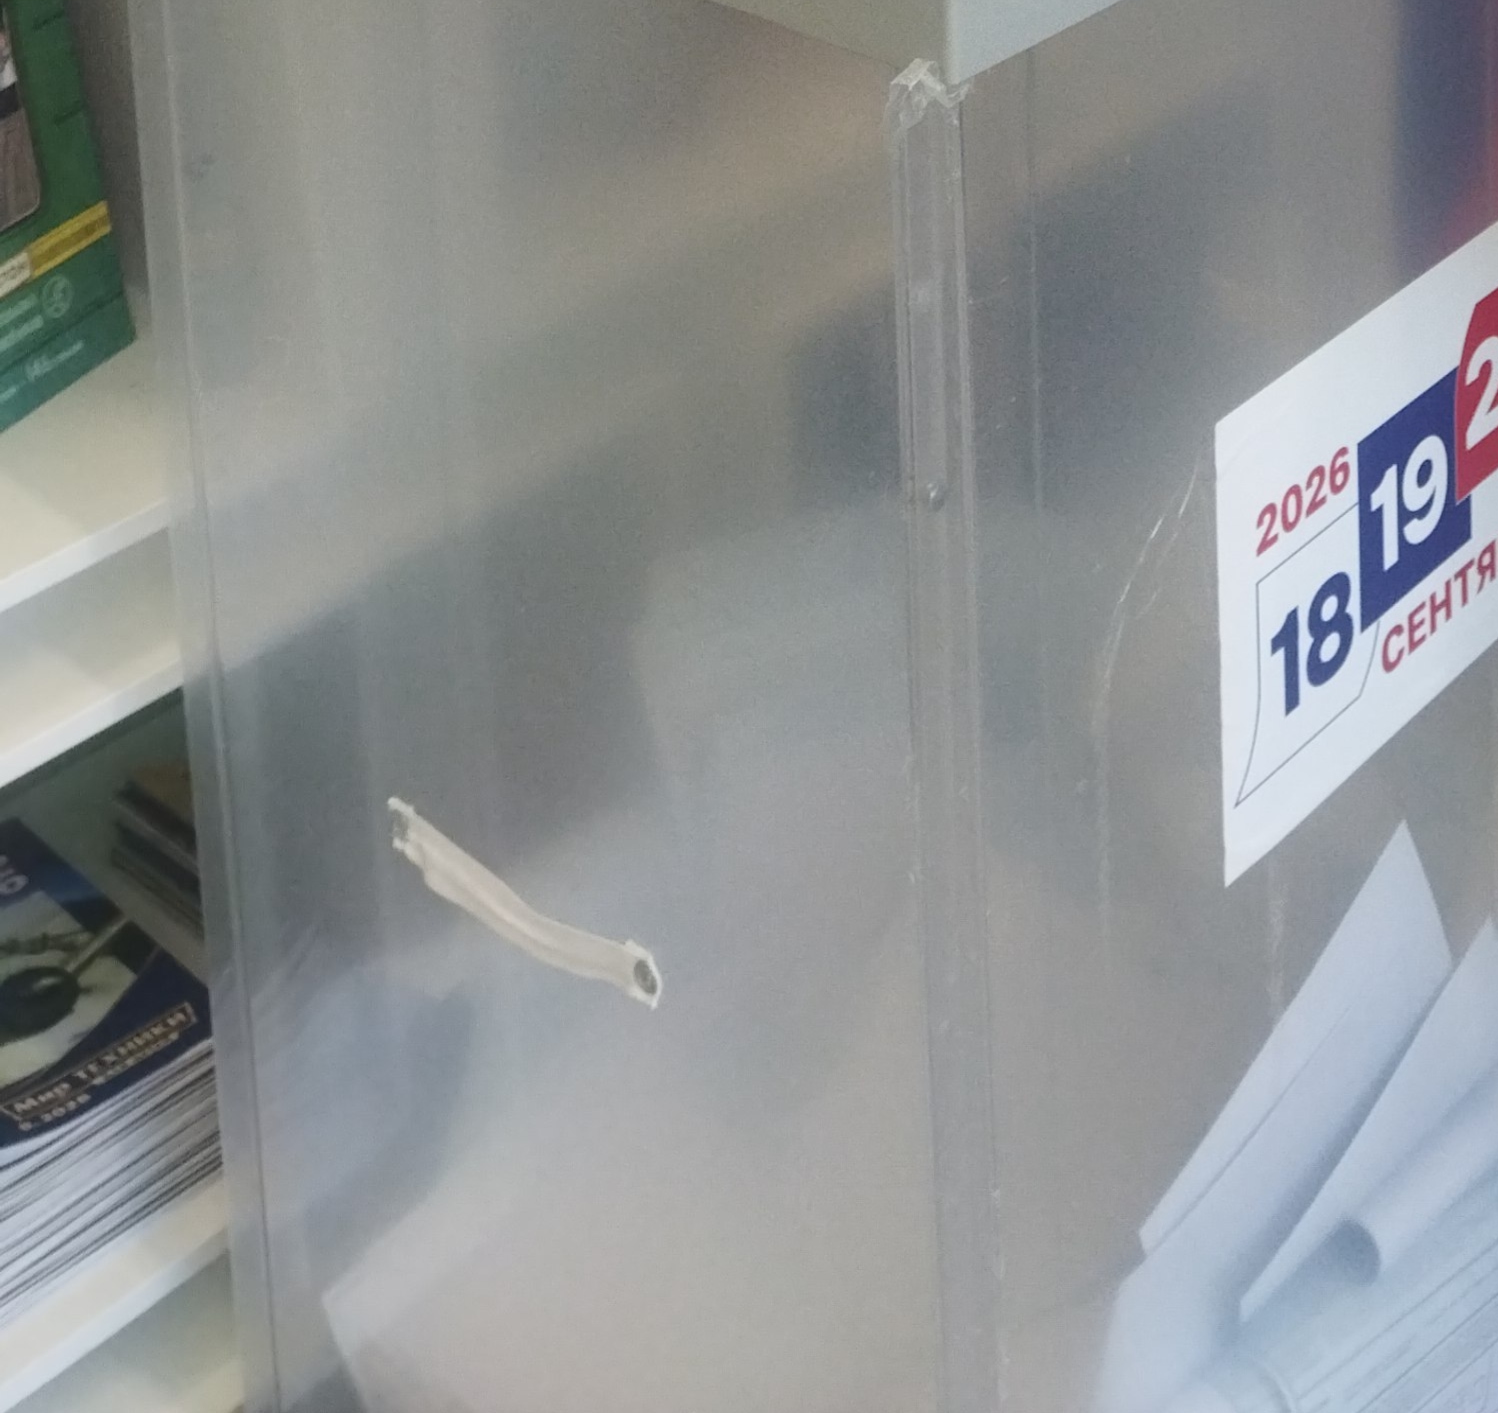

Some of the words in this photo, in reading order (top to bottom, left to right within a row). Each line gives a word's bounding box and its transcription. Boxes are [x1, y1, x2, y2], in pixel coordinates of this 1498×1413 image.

[1255, 446, 1351, 557] 2026
[1368, 434, 1449, 572] 19
[1270, 571, 1354, 718] 18
